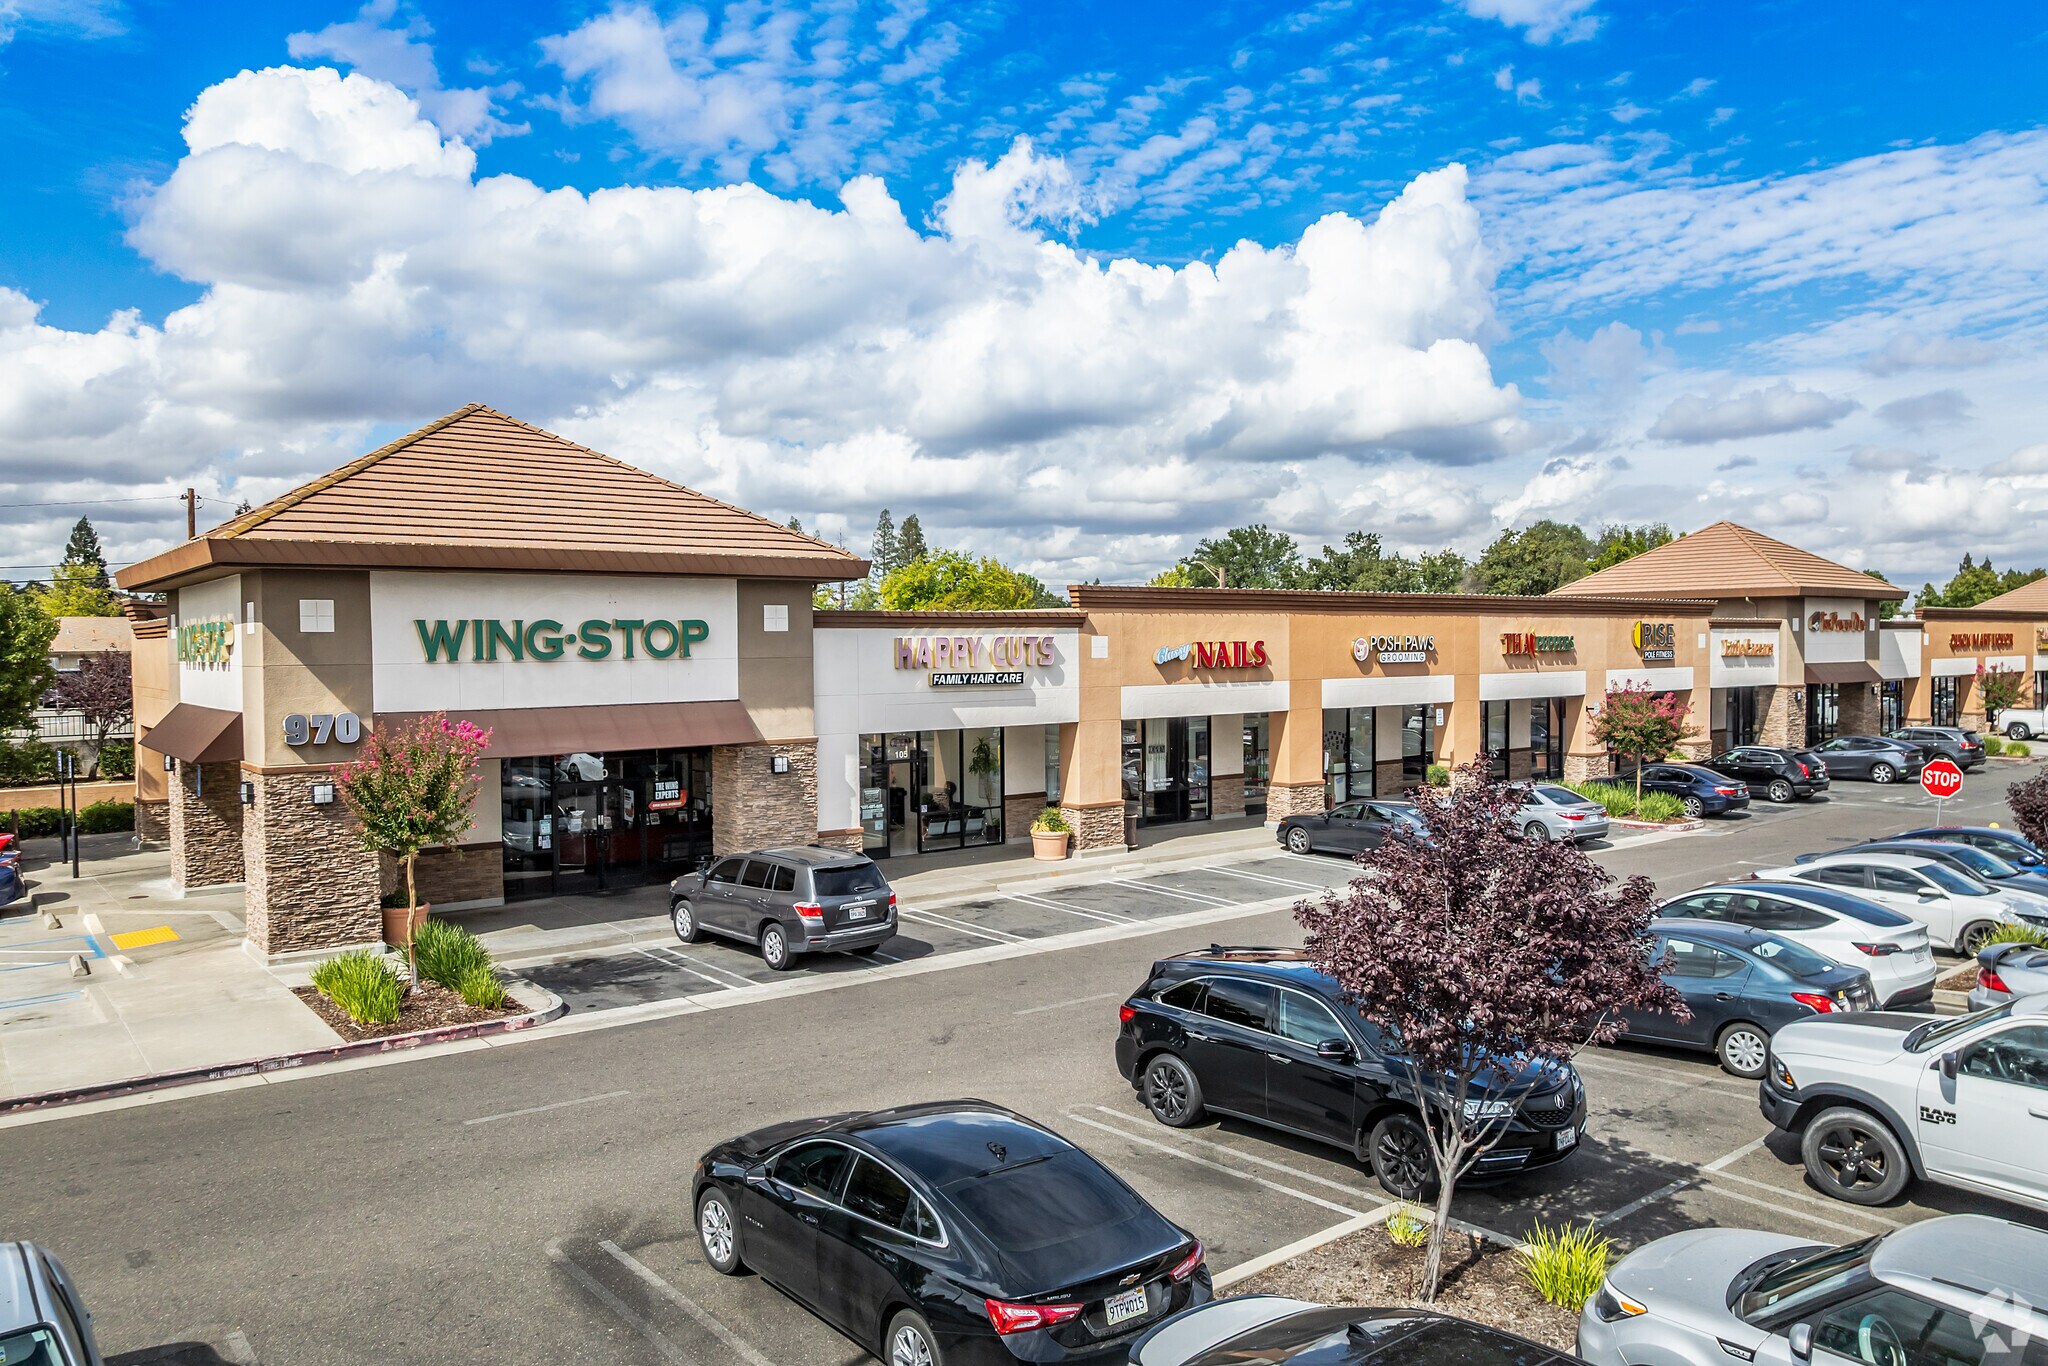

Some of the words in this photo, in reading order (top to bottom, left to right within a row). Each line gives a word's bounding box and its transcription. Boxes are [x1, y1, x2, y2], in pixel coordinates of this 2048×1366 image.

[1370, 635, 1402, 652] POSH
[1404, 635, 1436, 651] PAWS
[1642, 624, 1676, 647] RISE
[894, 636, 983, 669] HAPPY
[990, 636, 1055, 667] CUTS
[1153, 643, 1191, 665] Classy
[1192, 640, 1266, 668] NAILS
[1380, 652, 1425, 663] GROOMING
[1645, 651, 1657, 659] POLE
[1657, 650, 1674, 659] FITNESS
[933, 674, 969, 685] FAMILY
[970, 674, 994, 685] HAIR
[995, 673, 1023, 684] CARE
[283, 712, 360, 745] 970
[1924, 769, 1960, 787] STOP
[655, 790, 679, 800] EXPERTS
[1920, 1105, 1956, 1118] RAM
[1109, 1296, 1145, 1320] 9TPW015
